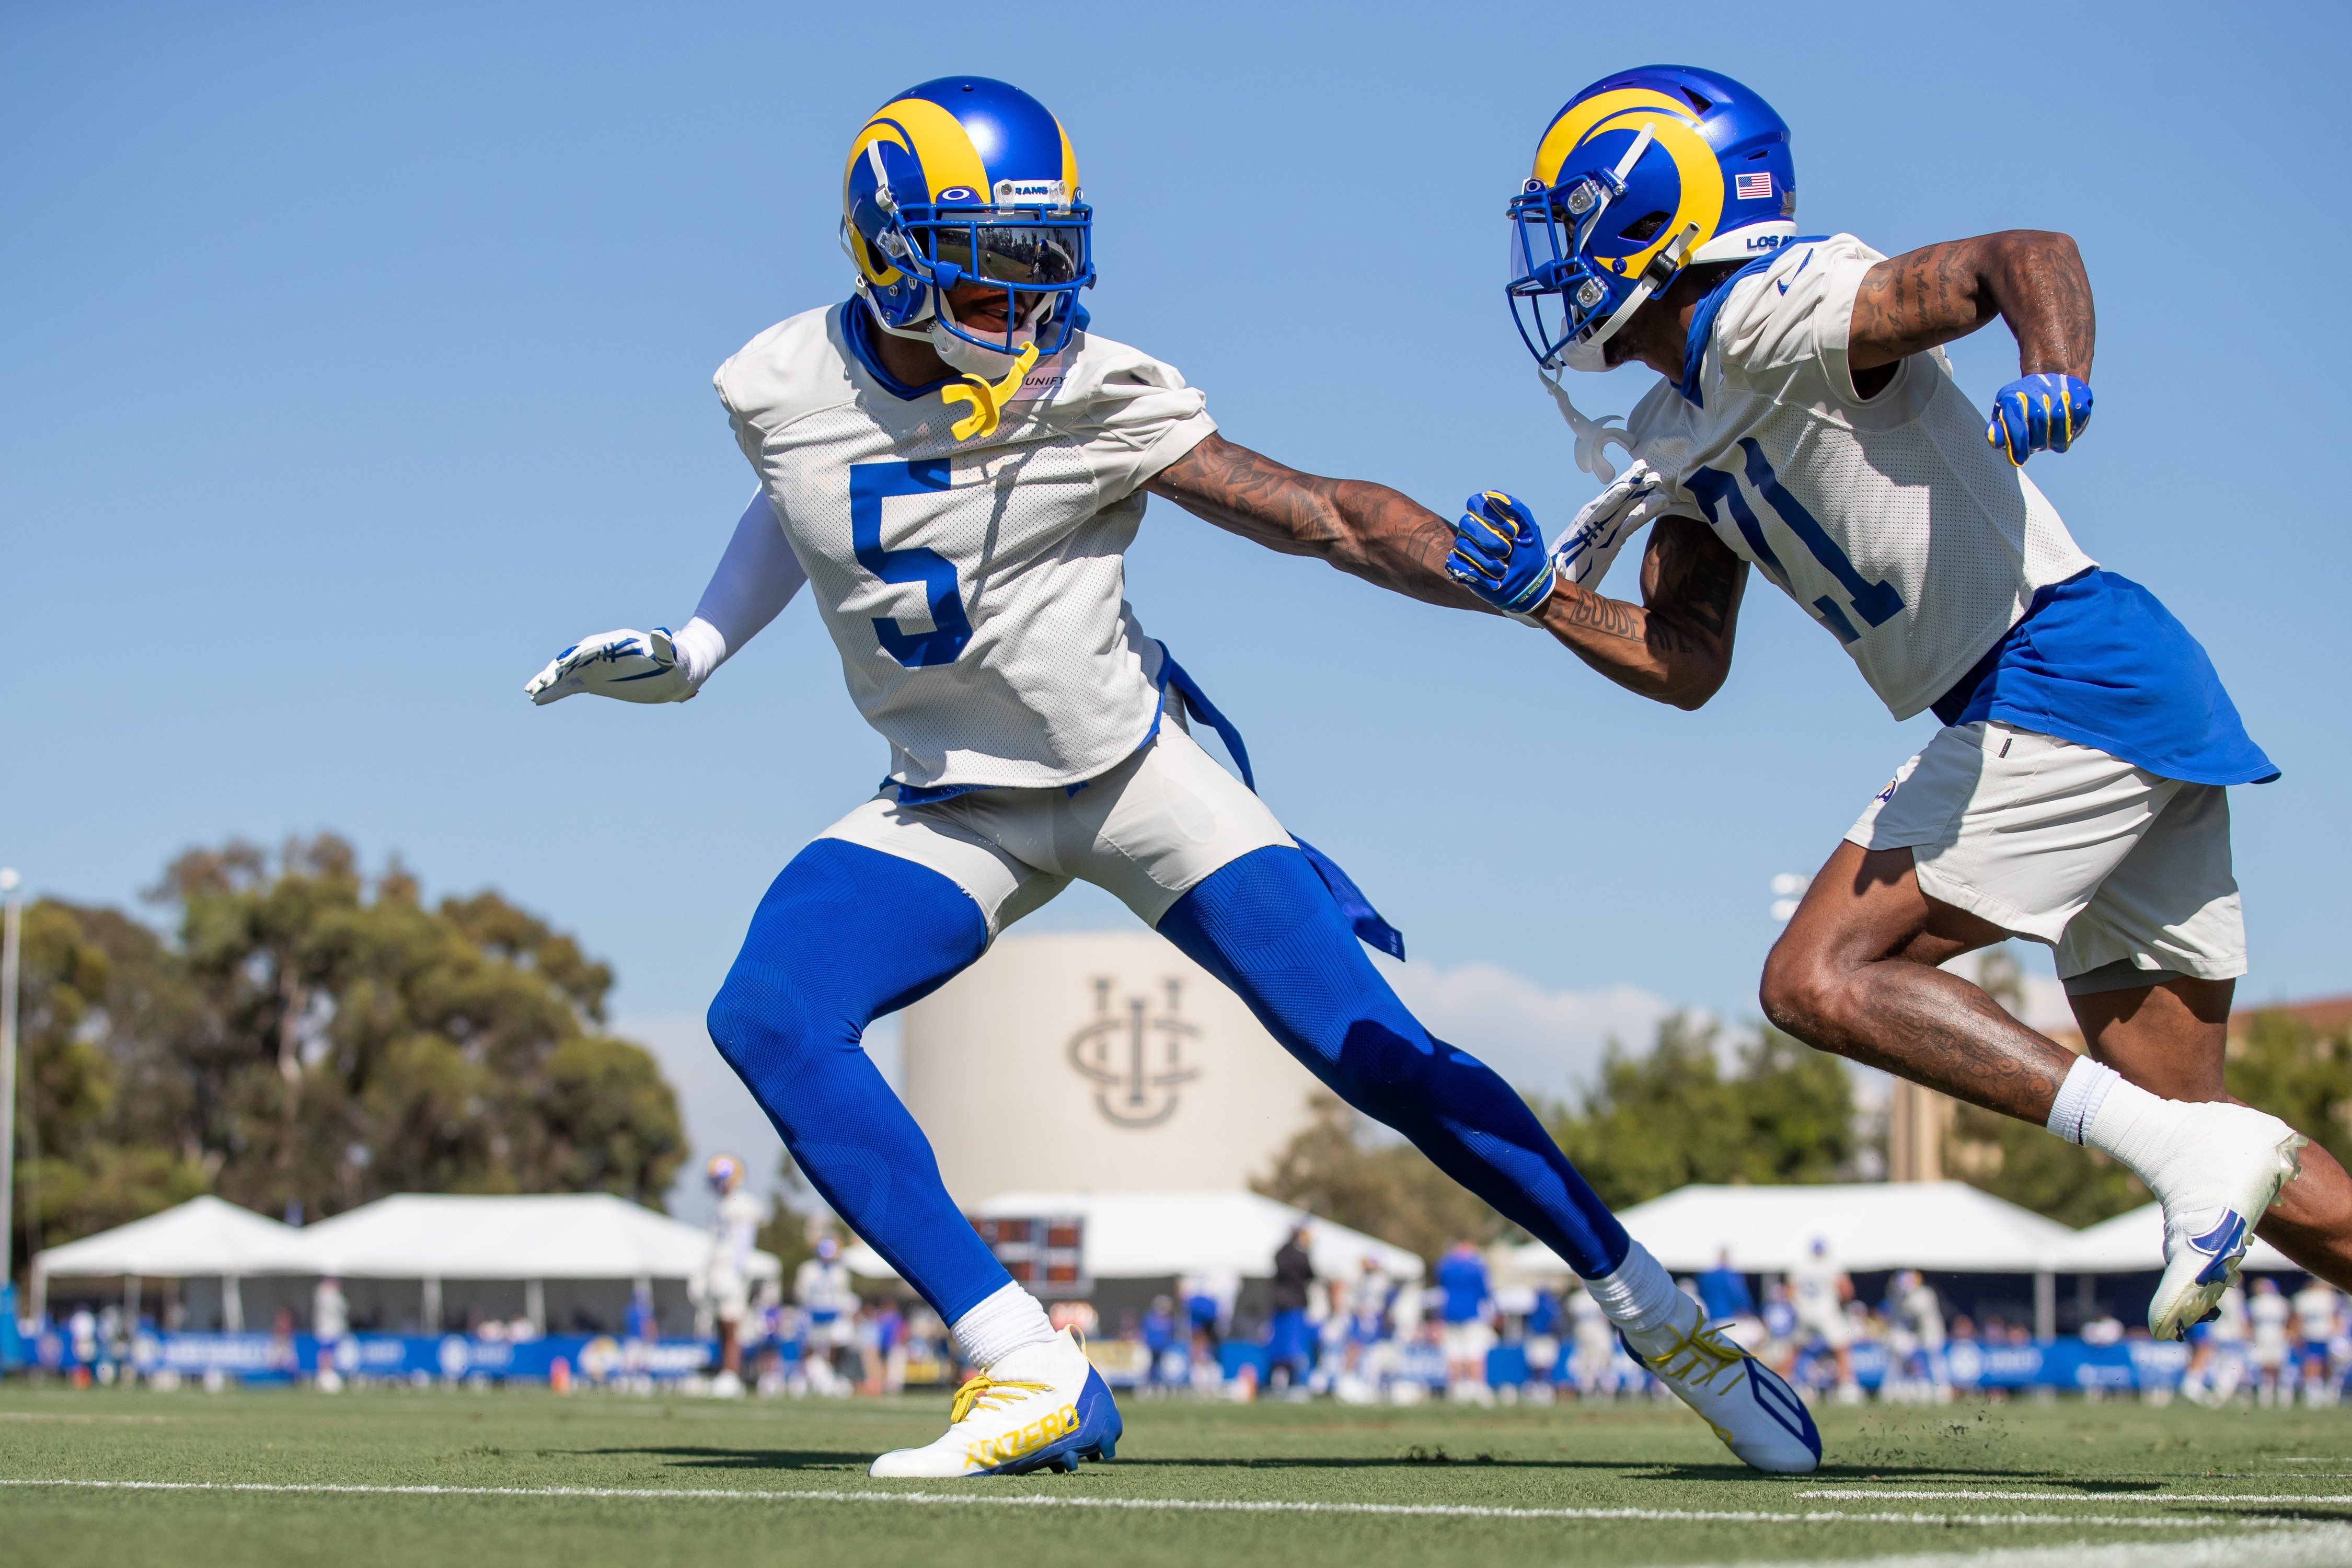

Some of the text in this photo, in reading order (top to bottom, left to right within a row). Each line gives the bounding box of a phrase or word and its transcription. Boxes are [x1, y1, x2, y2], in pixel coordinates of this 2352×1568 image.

[1015, 187, 1048, 195] RAMS
[1747, 235, 1779, 249] LOS
[1025, 377, 1067, 386] UNIFY
[849, 458, 974, 667] 5
[1528, 582, 1541, 595] Camp
[1518, 594, 1529, 603] 2021
